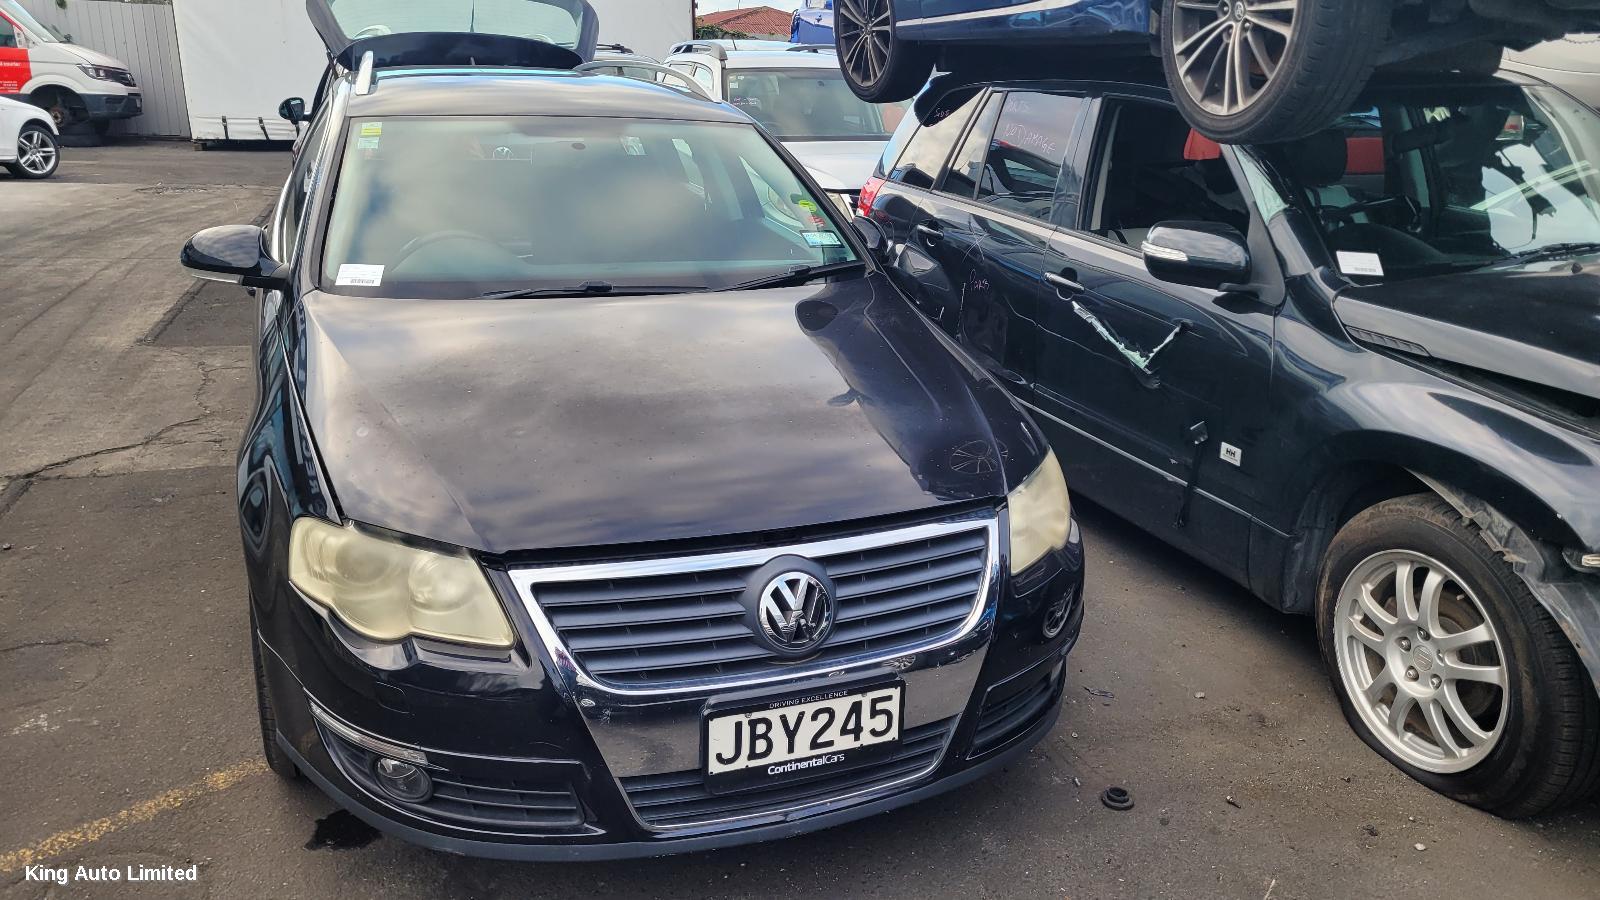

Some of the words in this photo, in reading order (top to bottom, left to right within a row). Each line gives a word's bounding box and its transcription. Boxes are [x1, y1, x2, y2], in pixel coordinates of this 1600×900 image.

[1225, 447, 1236, 458] HH
[769, 697, 800, 709] DRIVING
[801, 690, 848, 704] EXCELLENCE
[715, 694, 893, 766] JBY245
